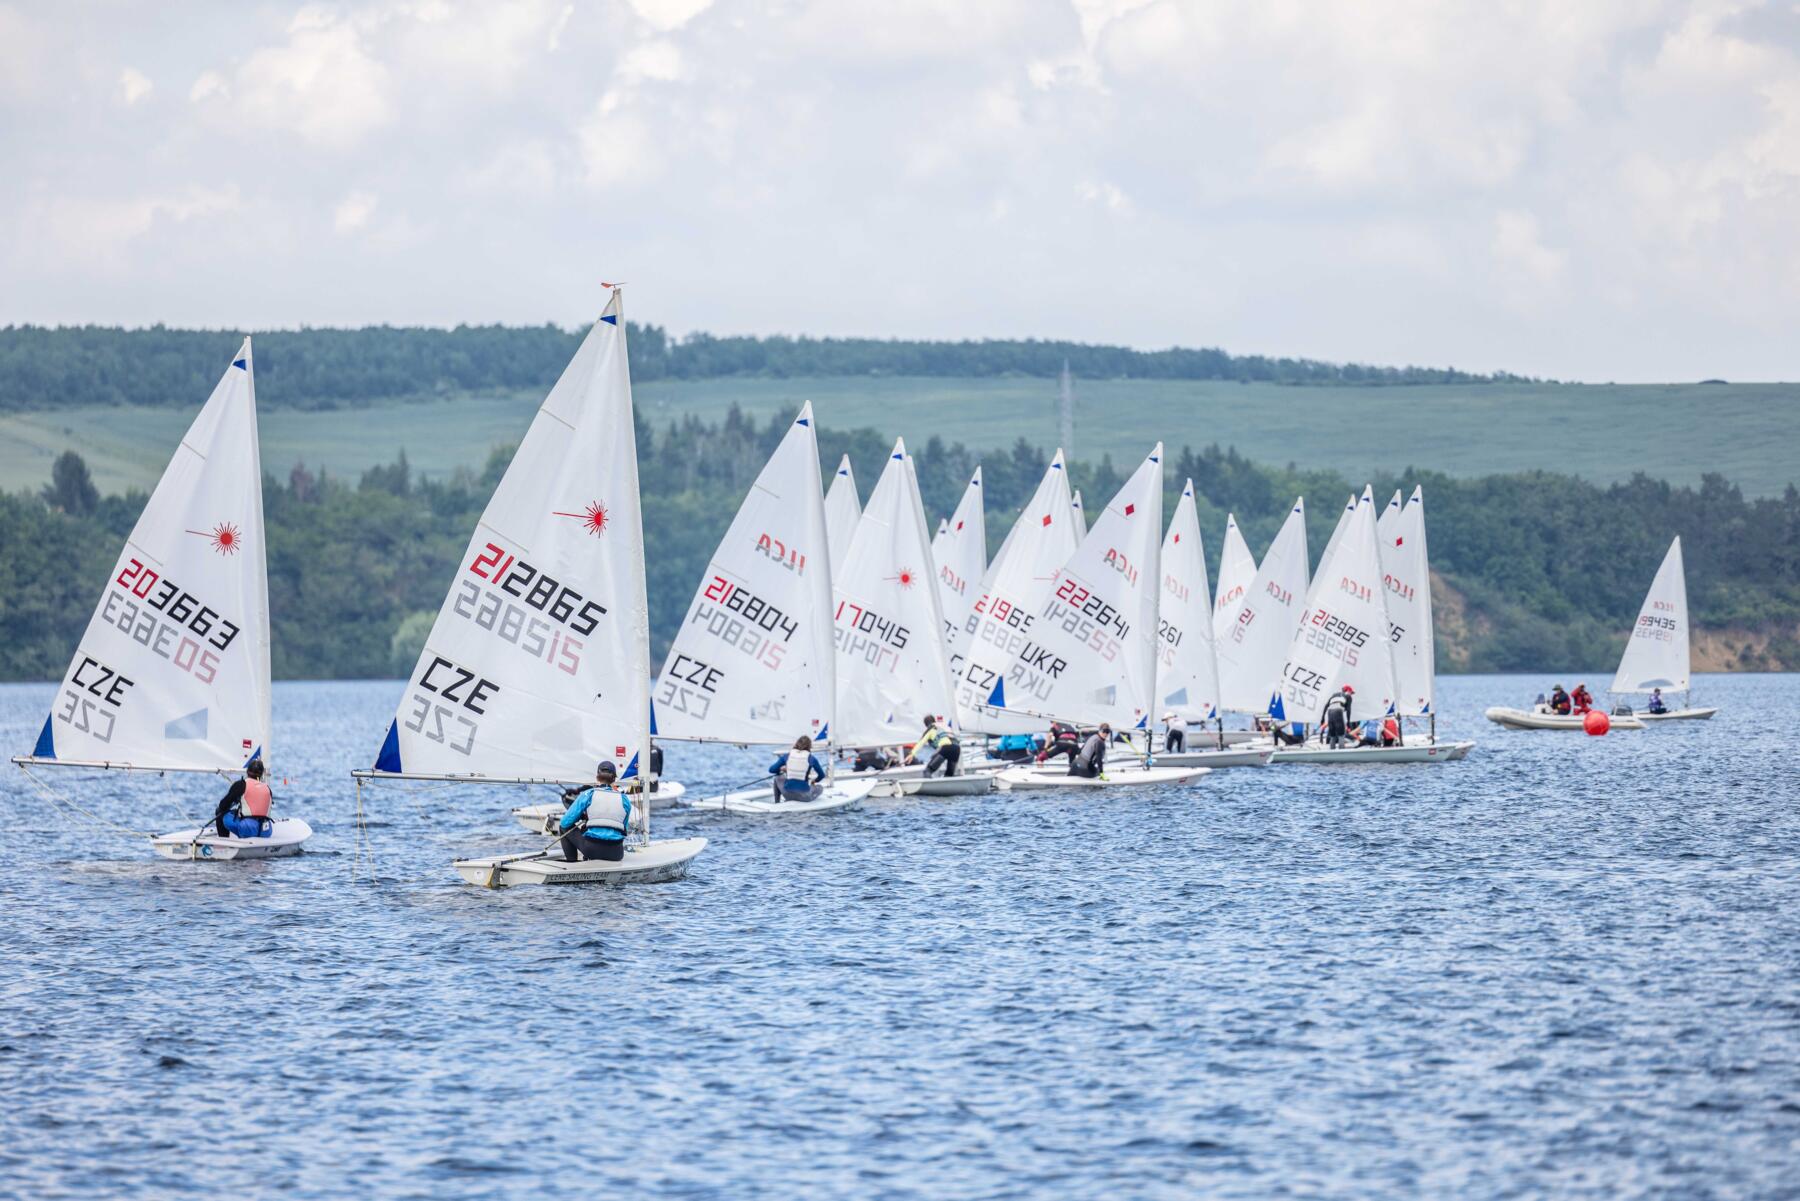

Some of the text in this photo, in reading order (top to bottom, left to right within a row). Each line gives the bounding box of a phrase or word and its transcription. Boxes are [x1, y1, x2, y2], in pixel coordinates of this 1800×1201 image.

[116, 558, 240, 651] 203663
[470, 542, 607, 636] 212865
[704, 576, 798, 642] 216804
[1056, 579, 1129, 640] 222641
[1218, 585, 1243, 610] ILCA
[835, 601, 910, 649] 170415
[1158, 617, 1182, 646] 261
[1312, 609, 1369, 647] 212985
[1639, 615, 1676, 630] 199435
[72, 657, 134, 707] CZE
[669, 655, 724, 693] CZE
[1020, 642, 1067, 679] UKR
[1291, 666, 1326, 691] CZE
[419, 656, 500, 715] CZE
